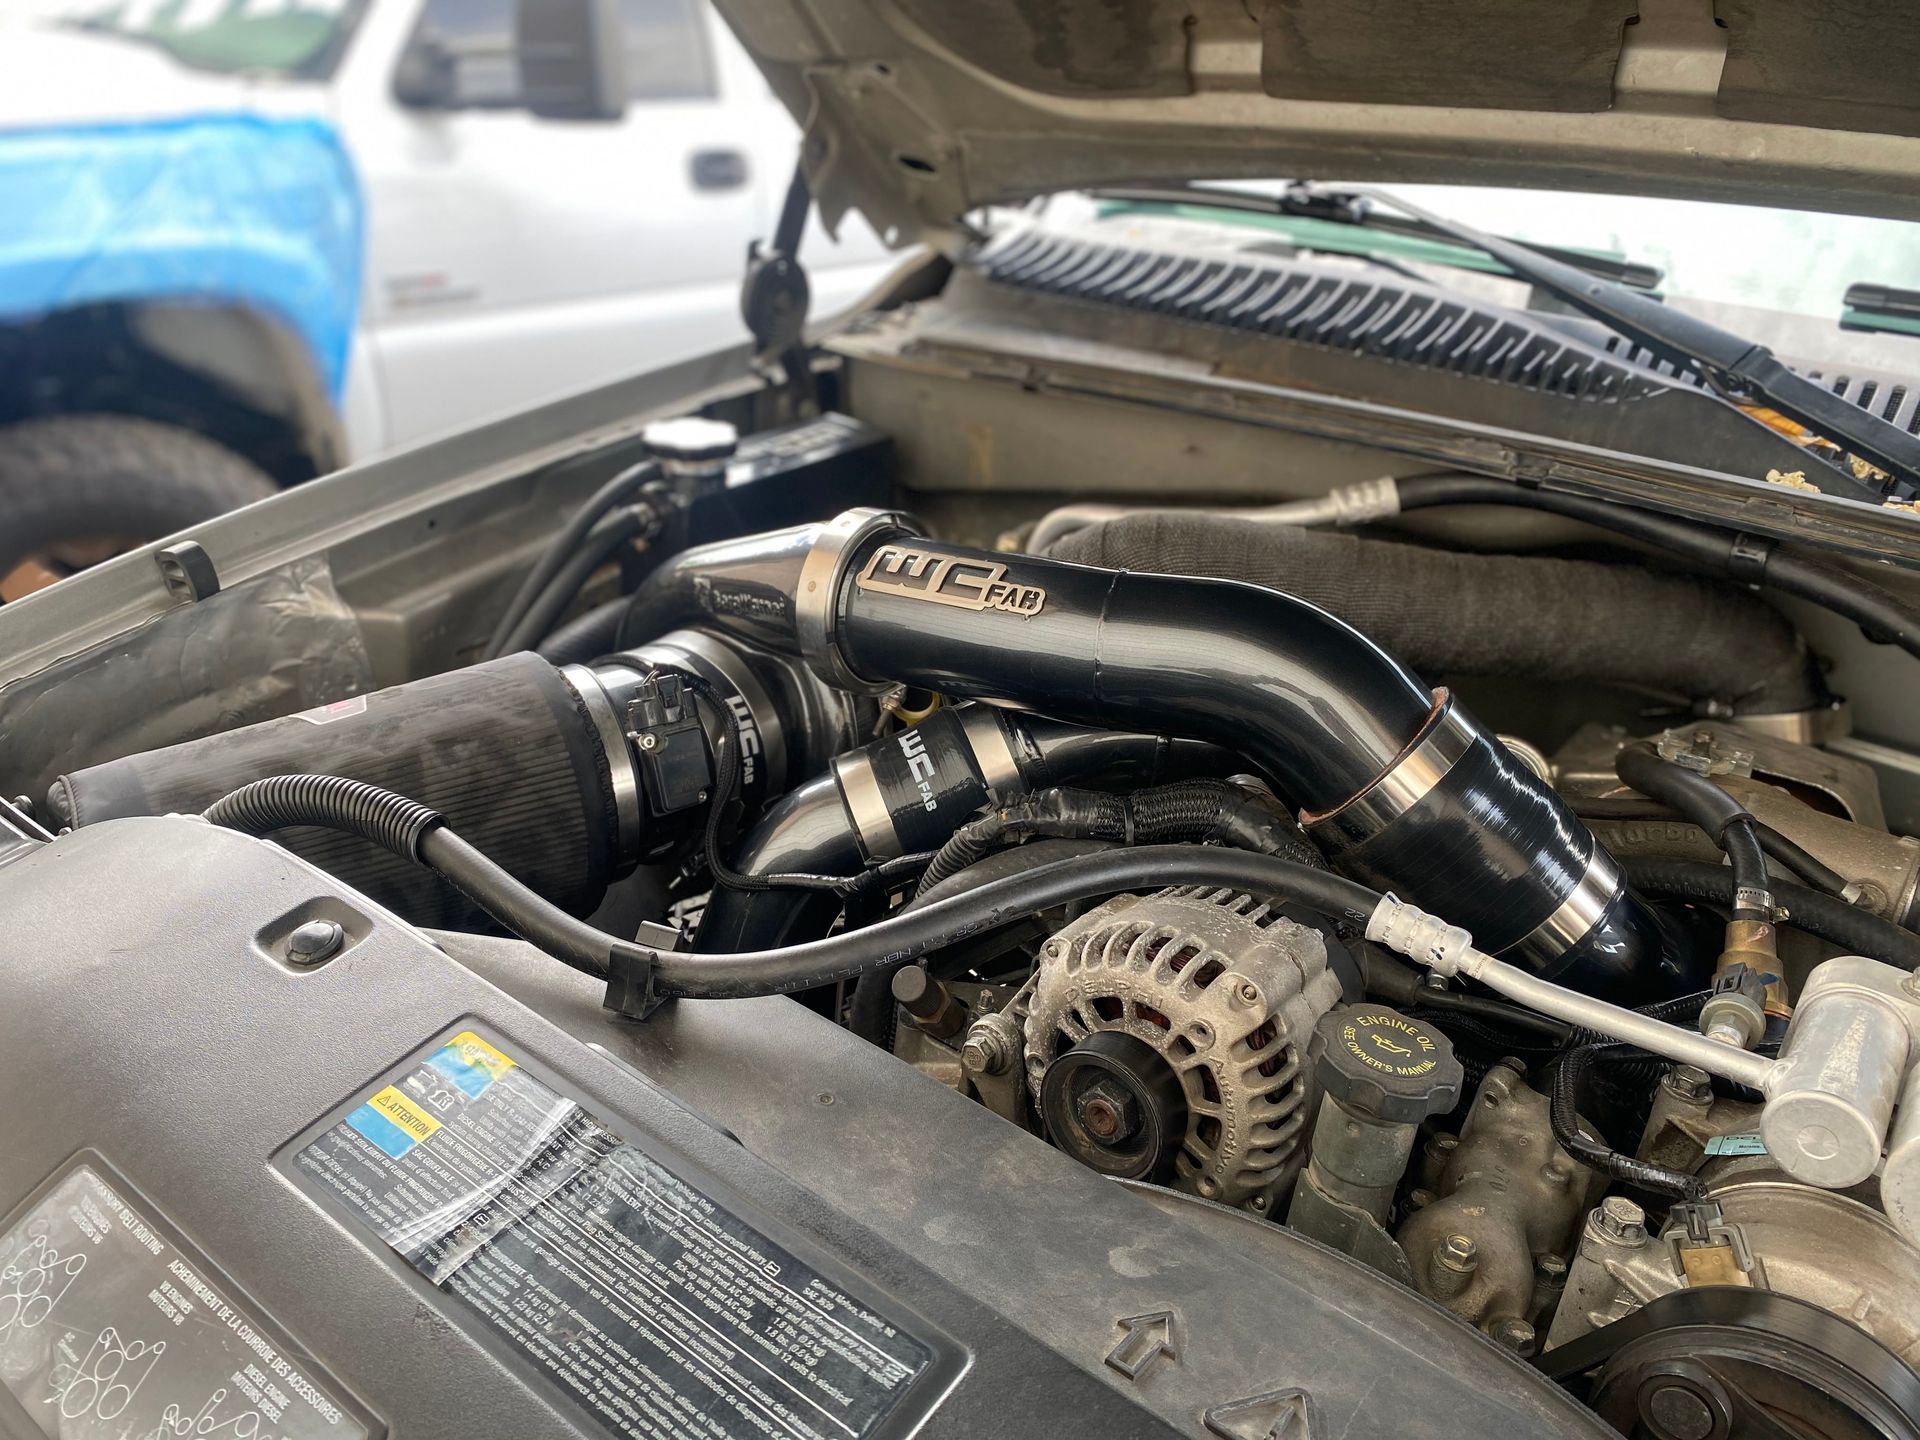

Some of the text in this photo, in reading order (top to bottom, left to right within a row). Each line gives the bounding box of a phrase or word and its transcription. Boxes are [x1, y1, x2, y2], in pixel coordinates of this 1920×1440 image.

[986, 583, 1045, 613] FAB
[743, 756, 755, 785] FAB
[916, 781, 938, 812] FAB
[1344, 1025, 1437, 1076] SEE OWNER'S MANUAL
[1356, 1015, 1436, 1052] ENGINE OIL
[387, 1102, 430, 1135] ATTENTION
[117, 1209, 139, 1229] BELT
[132, 1224, 164, 1254] ROUTING
[696, 1200, 715, 1214] Only)
[435, 1130, 456, 1146] FLUIDE
[562, 1227, 580, 1242] (pour
[578, 1238, 589, 1247] les
[586, 1245, 616, 1268] véhicules
[613, 1266, 629, 1279] avec
[626, 1276, 654, 1298] système
[652, 1295, 662, 1303] de
[660, 1301, 700, 1332] climatisation
[697, 1330, 735, 1360] seulement)
[568, 1210, 670, 1288] Glow Plug Starting System can result.
[689, 1210, 768, 1266] may cause personal injury.
[158, 1281, 193, 1314] V8 ENGINES
[412, 1149, 425, 1159] SAC
[557, 1264, 591, 1290] accidentel,
[589, 1288, 603, 1299] voir
[607, 1302, 631, 1321] manuel
[629, 1319, 639, 1328] de
[636, 1326, 670, 1352] réparation
[667, 1351, 685, 1364] pour
[683, 1362, 695, 1371] les
[693, 1369, 728, 1396] méthodes
[725, 1394, 737, 1404] de
[733, 1402, 773, 1434] diagnostic
[585, 1209, 817, 1381] Immediate engine damage can result. Do not apply more than nominal 12 volts to
[648, 1213, 821, 1338] prevent damage to A/C system, use synthetic oil and follow
[654, 1203, 843, 1340] Manual for diagnostic and service procedures before performing
[802, 1287, 818, 1300] SAE
[147, 1289, 184, 1325] MOTEURS V8
[562, 1243, 789, 1416] qualifié seulement. Des méthodes d'entretien incorrectes peuvent causer des
[672, 1259, 818, 1366] Pick-up with front A/C only 1.8 lbs. kg)
[680, 1252, 827, 1357] Utility with front A/C only 1.8 lbs. kg)
[167, 1258, 343, 1426] ACHEMINEMENT DE LA COURROIE DES ACCESSOIRES
[522, 1289, 690, 1423] 1,4 kg (3 avec système de climatisation
[523, 1307, 676, 1429] kg (2,7 avec système de climatisation
[536, 1283, 563, 1304] prévenir
[560, 1302, 570, 1310] les
[567, 1309, 600, 1334] dommages
[598, 1332, 607, 1340] au
[604, 1340, 630, 1360] système
[628, 1357, 639, 1366] de
[635, 1364, 677, 1396] climatisation,
[674, 1394, 698, 1413] utiliser
[695, 1412, 707, 1421] de
[230, 1371, 283, 1423] MOTEURS DIESEL
[243, 1364, 290, 1409] DIESEL ENGINE
[586, 1393, 598, 1402] du
[592, 1378, 604, 1388] Ne
